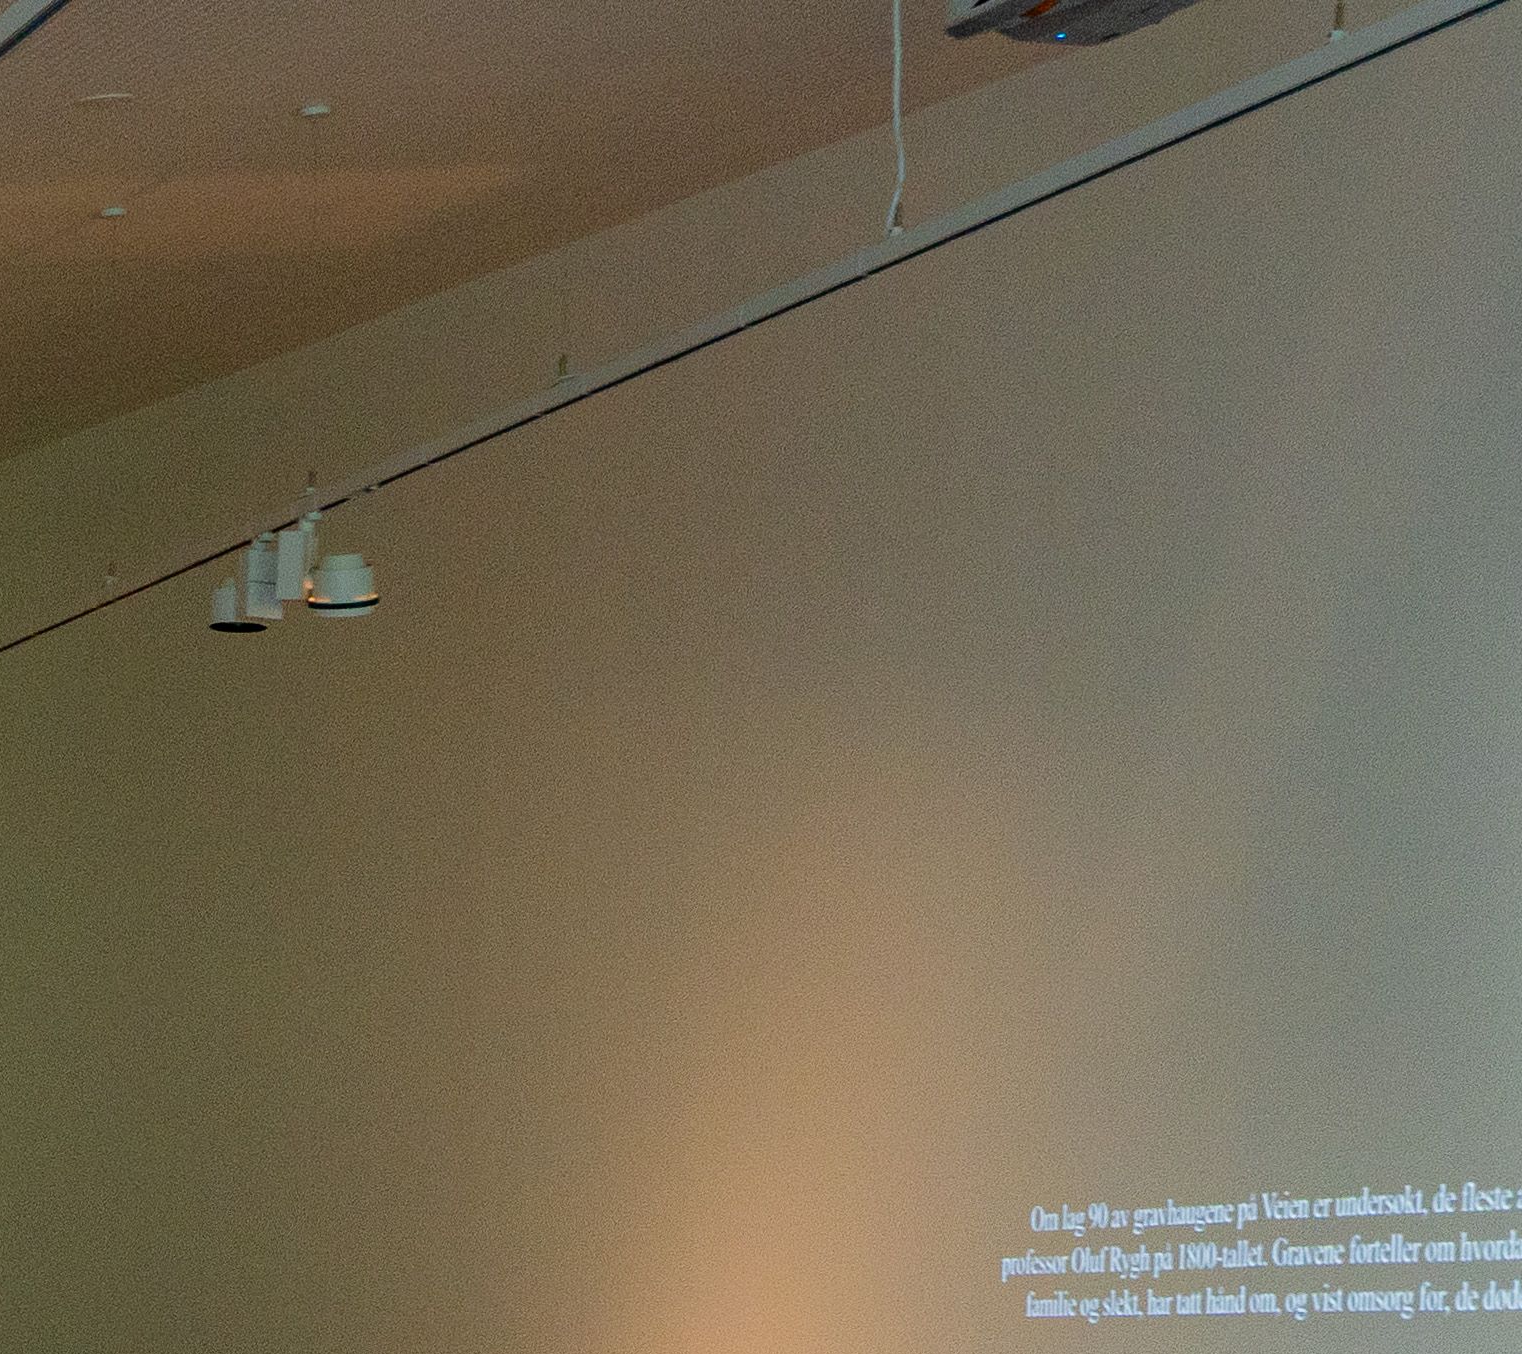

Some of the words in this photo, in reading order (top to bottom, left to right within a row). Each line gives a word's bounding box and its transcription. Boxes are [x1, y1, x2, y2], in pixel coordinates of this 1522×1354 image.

[1030, 1206, 1060, 1232] Om
[1061, 1204, 1086, 1237] lag
[1087, 1203, 1110, 1229] 90
[1111, 1210, 1130, 1229] av
[1133, 1199, 1234, 1235] gravhaugene
[1236, 1194, 1258, 1230] på
[1262, 1191, 1310, 1220] Veien
[1312, 1198, 1332, 1219] er
[1432, 1184, 1458, 1214] de
[1461, 1182, 1513, 1212] fleste
[1001, 1249, 1068, 1283] professor
[1152, 1243, 1174, 1278] på
[1271, 1237, 1345, 1267] Gravene
[1348, 1234, 1422, 1264] forteller
[1424, 1241, 1456, 1263] om
[1025, 1291, 1078, 1318] familie
[1079, 1298, 1100, 1324] og
[1146, 1289, 1173, 1317] har
[1284, 1293, 1308, 1321] og
[1311, 1284, 1344, 1312] vist
[1346, 1291, 1415, 1320] omsorg
[1454, 1281, 1480, 1311] de
